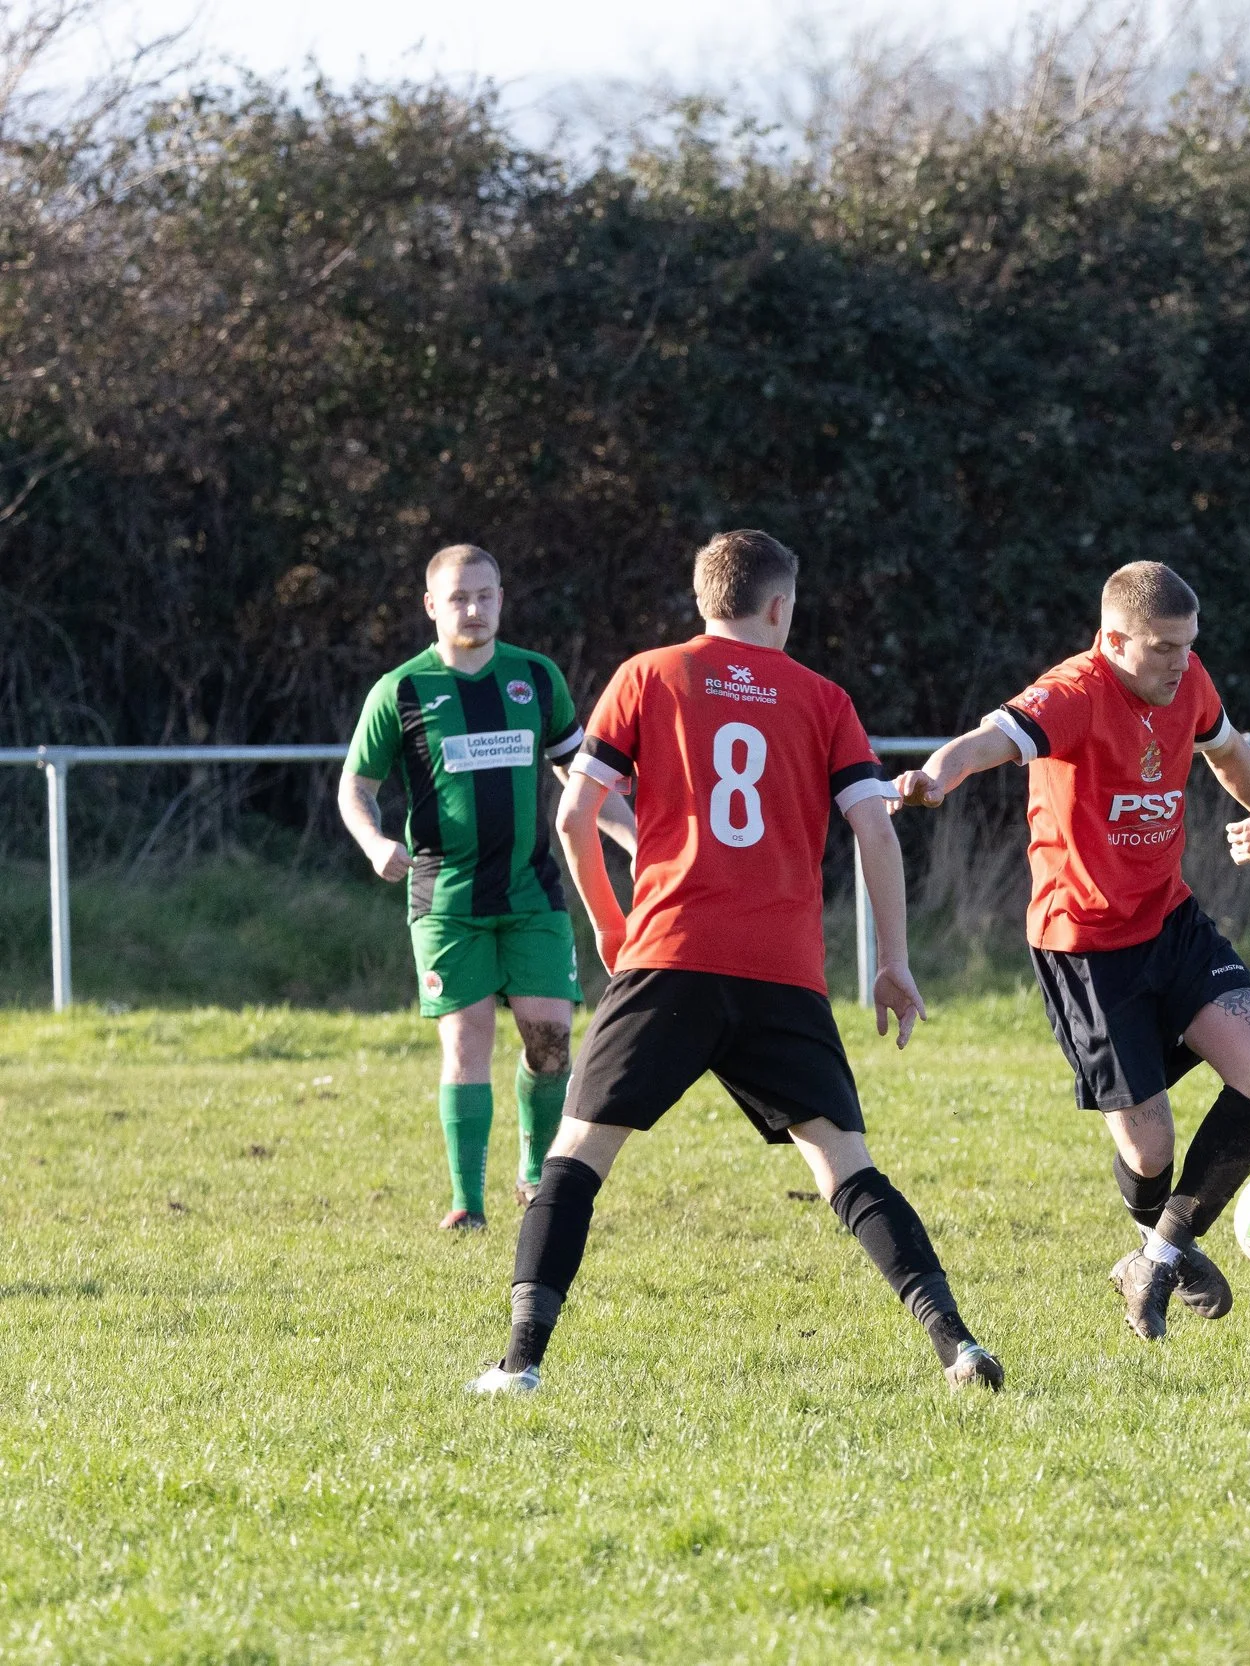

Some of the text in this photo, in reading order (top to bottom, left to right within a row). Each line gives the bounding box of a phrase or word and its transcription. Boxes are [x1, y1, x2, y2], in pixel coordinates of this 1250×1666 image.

[705, 678, 777, 697] RG HOWELLS
[705, 687, 777, 705] cleaning services
[467, 732, 522, 747] Lakeland
[710, 721, 767, 848] 8
[1108, 790, 1183, 821] PSS
